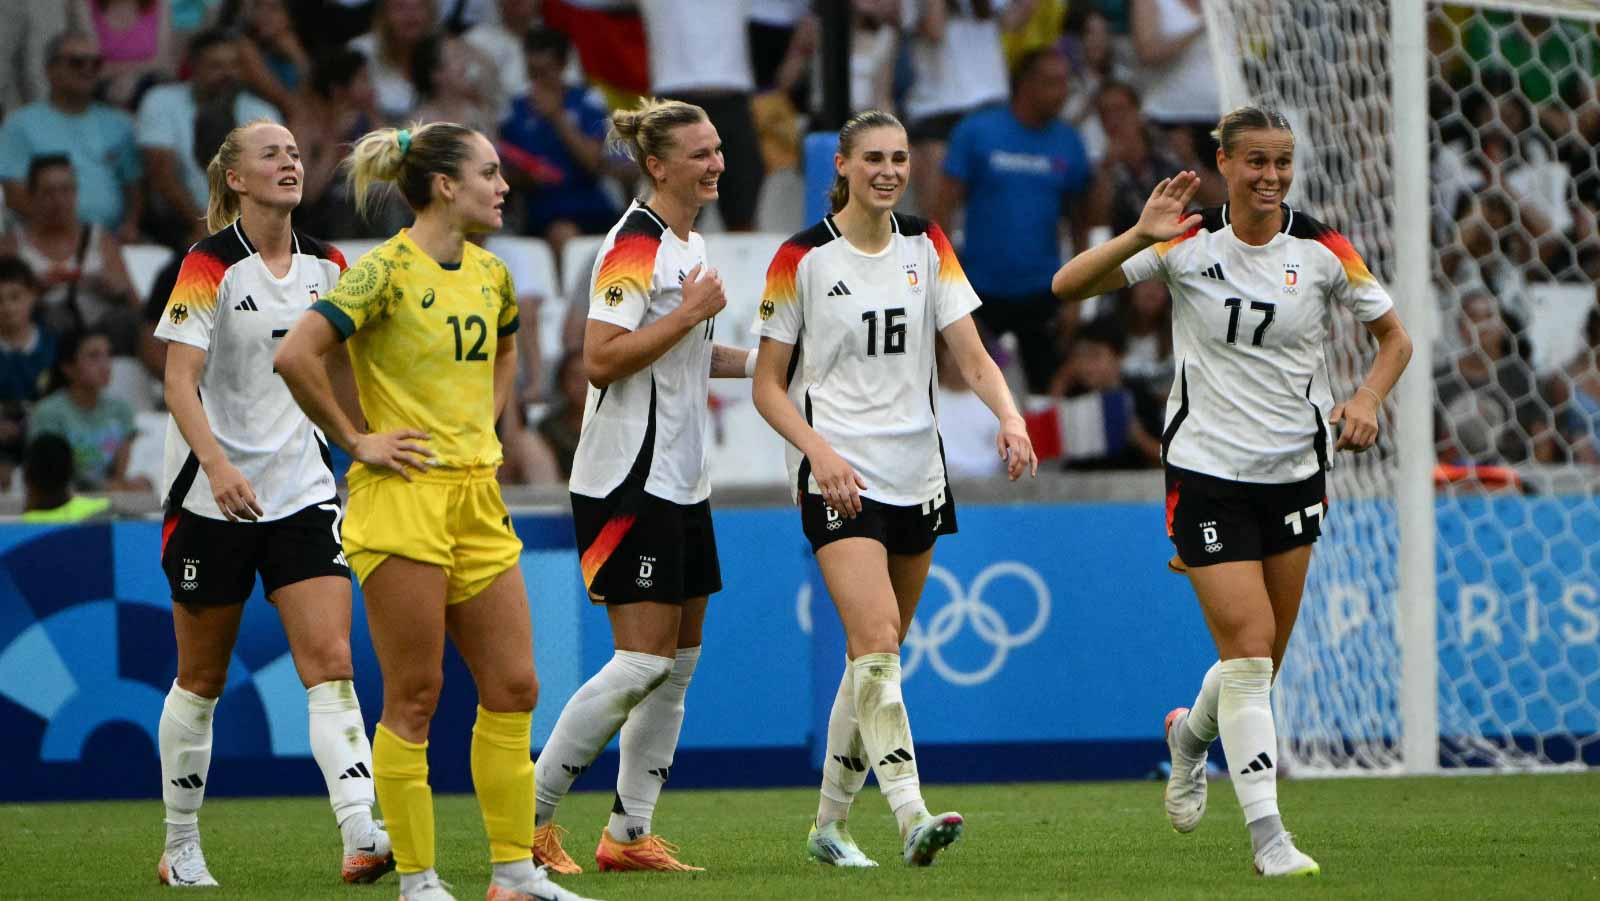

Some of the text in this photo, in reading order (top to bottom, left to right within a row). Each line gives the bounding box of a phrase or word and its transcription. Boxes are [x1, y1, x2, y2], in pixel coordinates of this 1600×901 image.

[446, 315, 488, 361] 12
[861, 307, 907, 358] 16
[1224, 297, 1276, 347] 17
[318, 504, 342, 544] 7
[1328, 583, 1600, 645] PRIS
